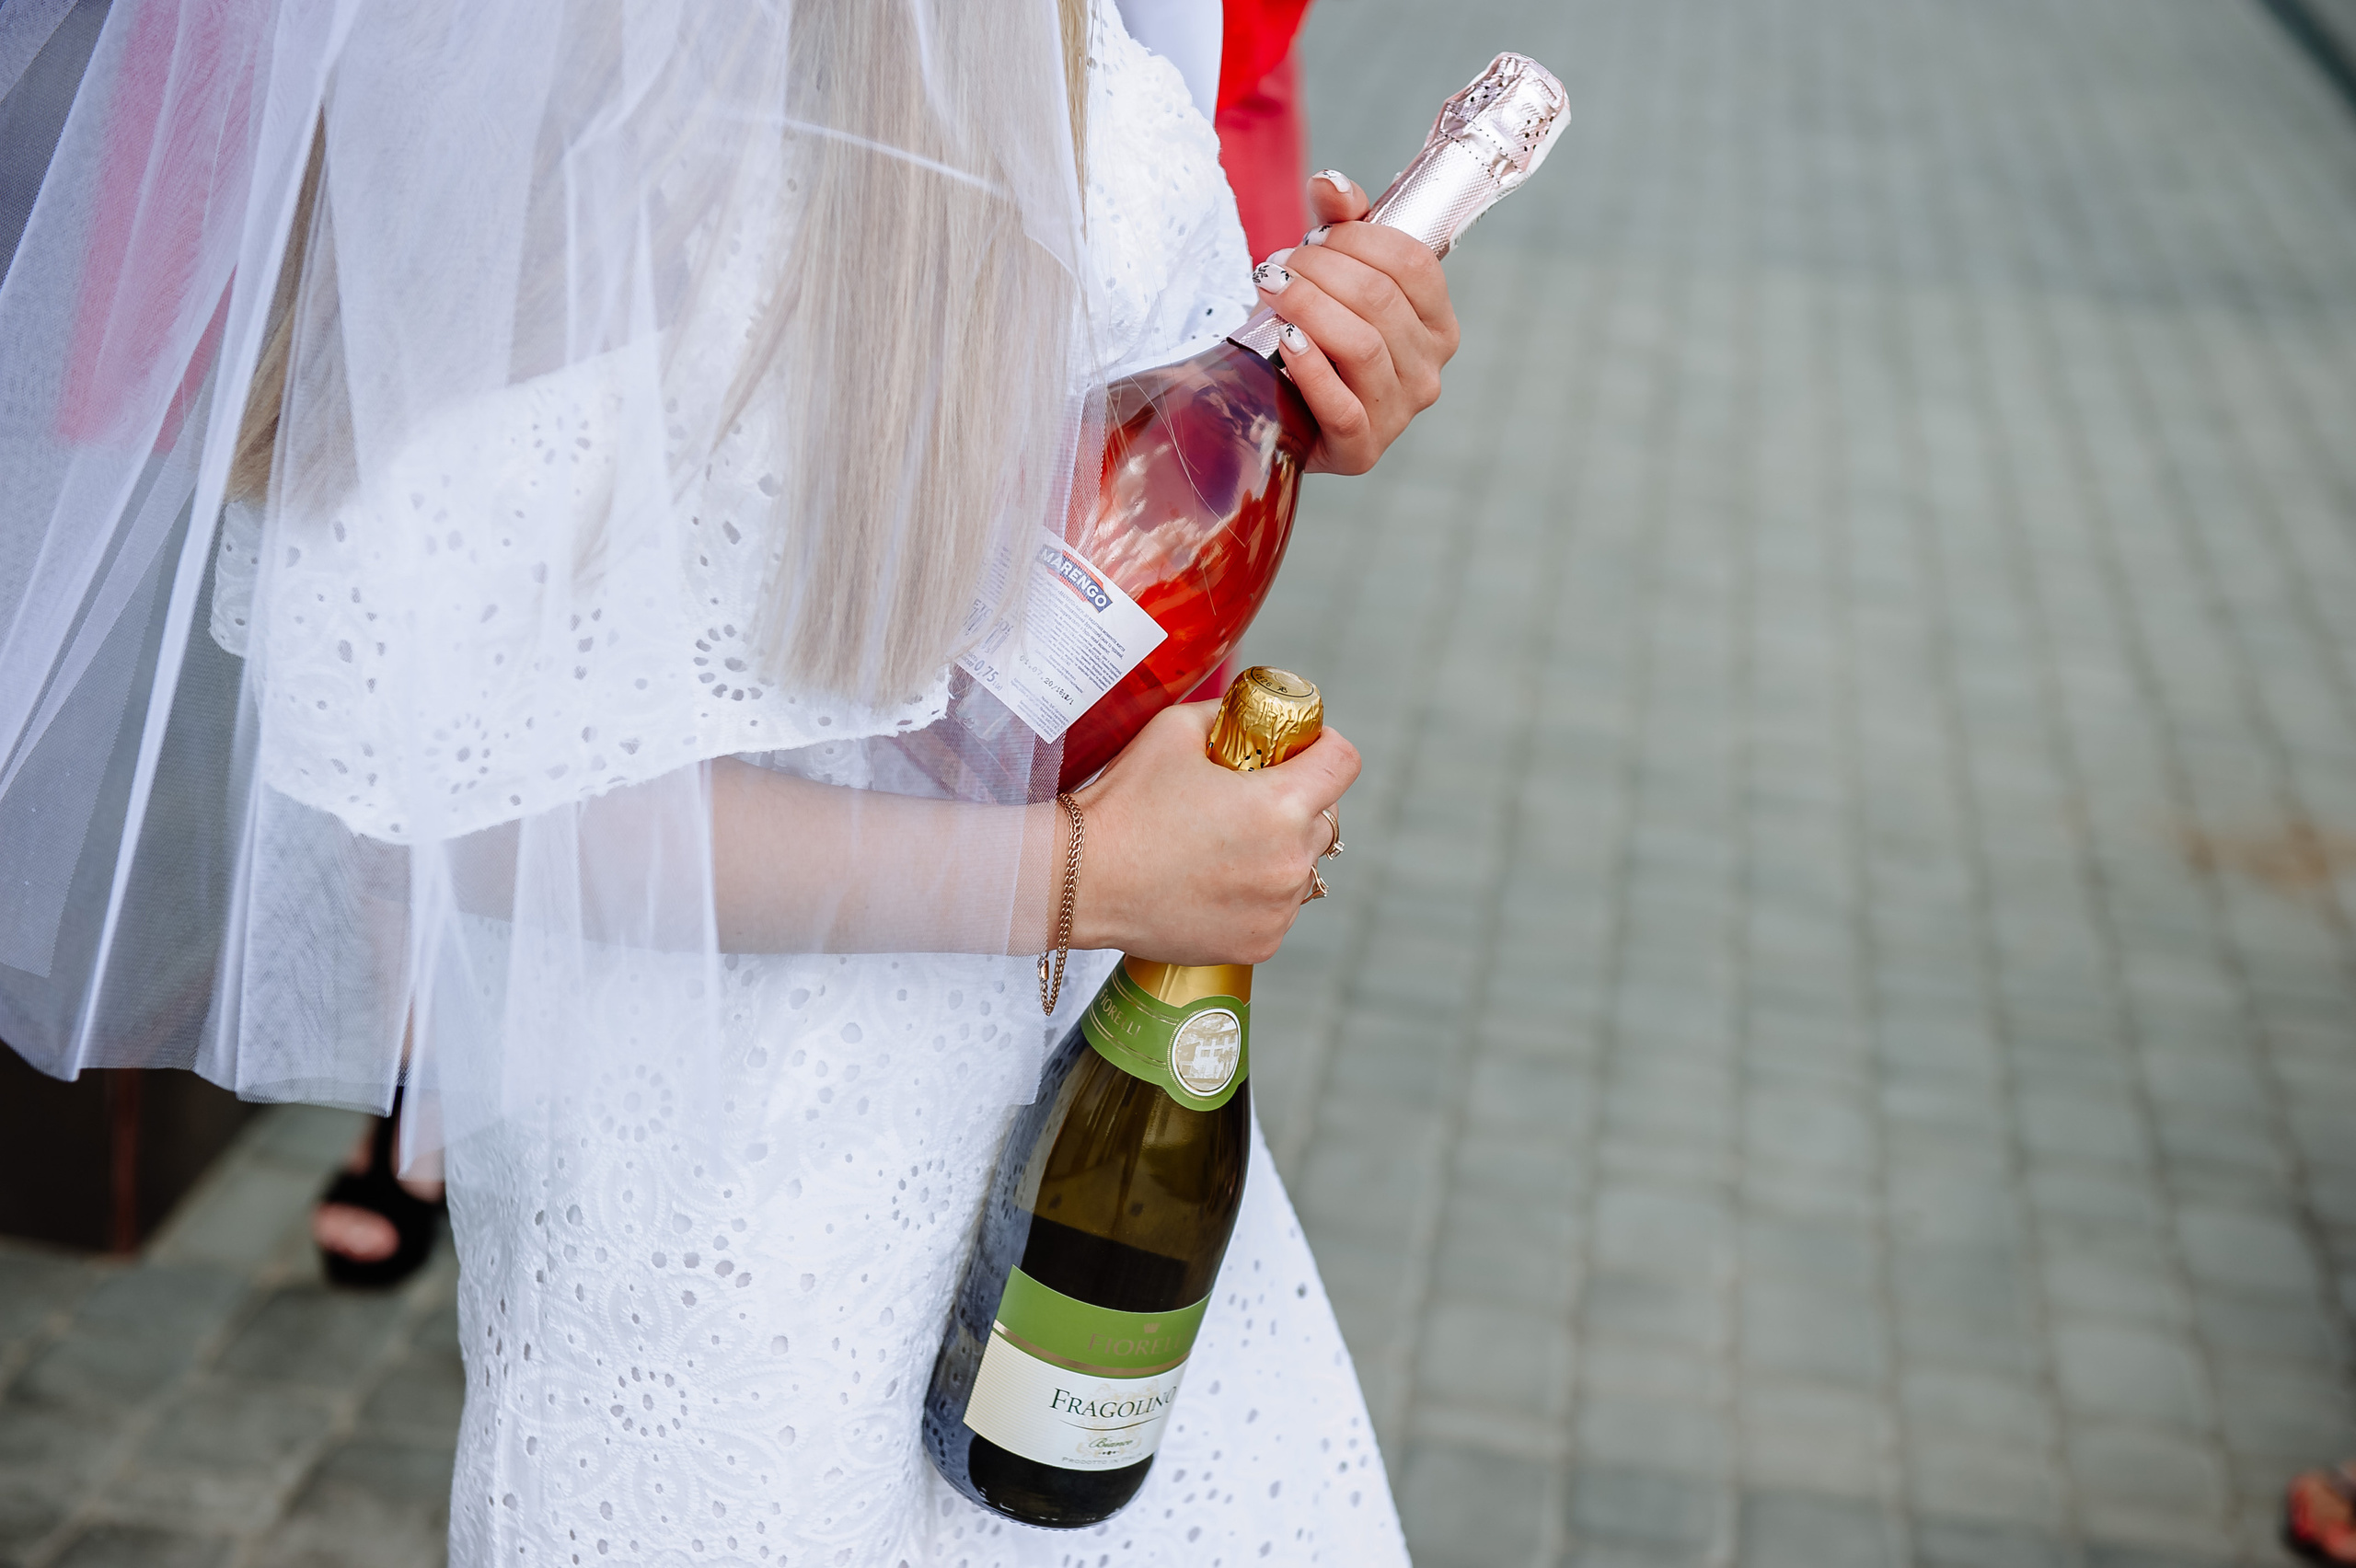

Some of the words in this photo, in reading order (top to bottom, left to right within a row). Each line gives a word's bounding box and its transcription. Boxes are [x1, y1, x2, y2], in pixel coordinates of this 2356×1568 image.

[1039, 548, 1108, 607] MARENGO
[974, 660, 999, 683] 0,75
[1098, 988, 1141, 1038] FIORELLI
[1049, 1386, 1177, 1418] FRAGOLINO
[1088, 1435, 1133, 1447] Bianco
[1061, 1456, 1107, 1465] PRODOTTO
